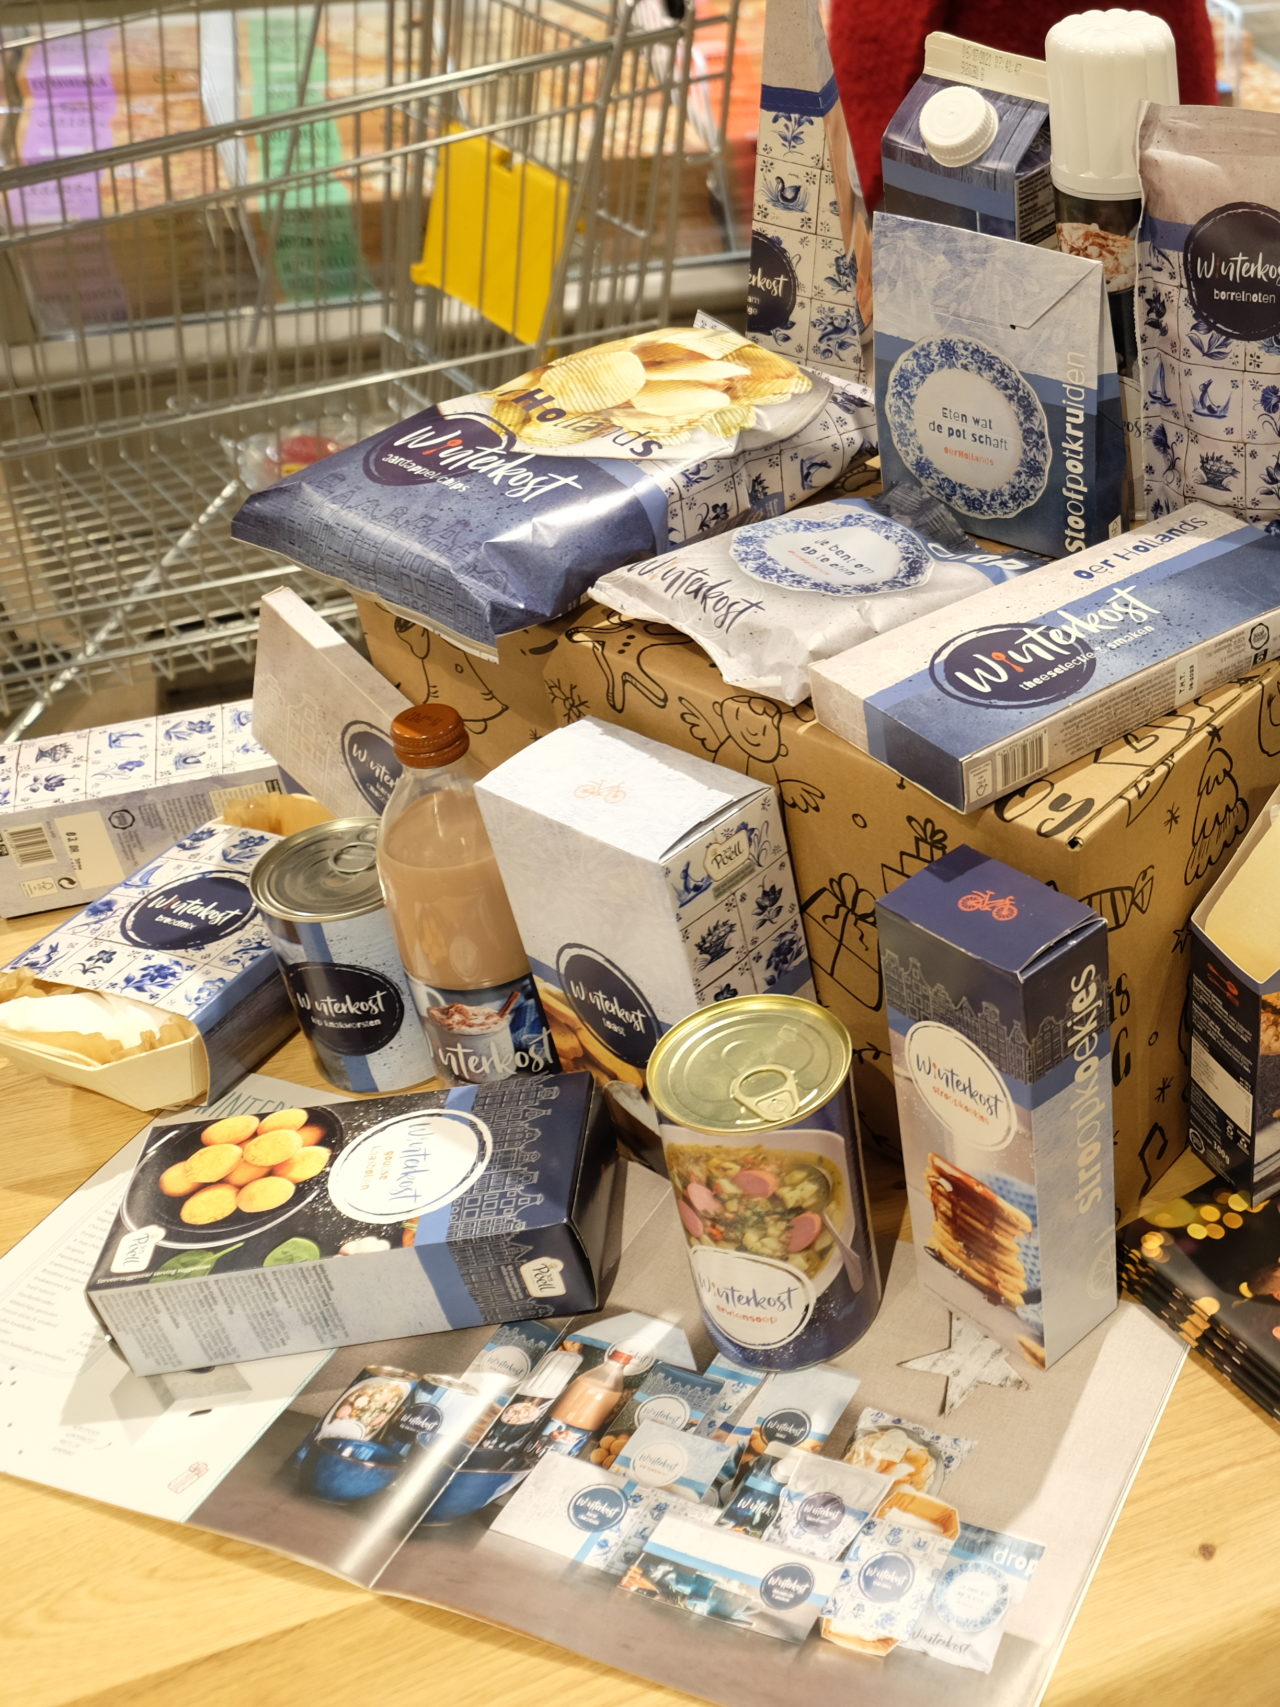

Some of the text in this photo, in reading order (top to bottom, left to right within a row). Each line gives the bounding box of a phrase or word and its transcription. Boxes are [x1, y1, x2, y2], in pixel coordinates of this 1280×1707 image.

[1213, 288, 1277, 304] borrelnoten
[510, 387, 664, 459] Hollands
[928, 420, 1009, 452] de pot schaft
[941, 407, 993, 430] Eten wat
[392, 425, 584, 503] Winterkost
[1061, 351, 1089, 554] stoofpotkruiden
[437, 475, 471, 493] chips
[801, 546, 857, 576] op te eten
[828, 544, 857, 563] bent
[854, 563, 875, 575] om
[1114, 514, 1210, 561] Hollands
[624, 557, 766, 634] Winterkost
[954, 585, 1162, 694] Winterkost
[1019, 650, 1097, 691] theeselectie
[1108, 624, 1156, 651] smaken
[351, 743, 397, 788] Winter
[147, 894, 243, 926] Winterkost
[297, 990, 387, 1017] Winterkost
[569, 979, 647, 1034] Winterkost
[437, 1026, 555, 1081] nterkost
[916, 1053, 1004, 1119] Winterkost
[1066, 963, 1106, 1215] stroopkoekjes
[388, 1122, 435, 1204] Winterkost
[697, 1271, 800, 1312] Winterkost
